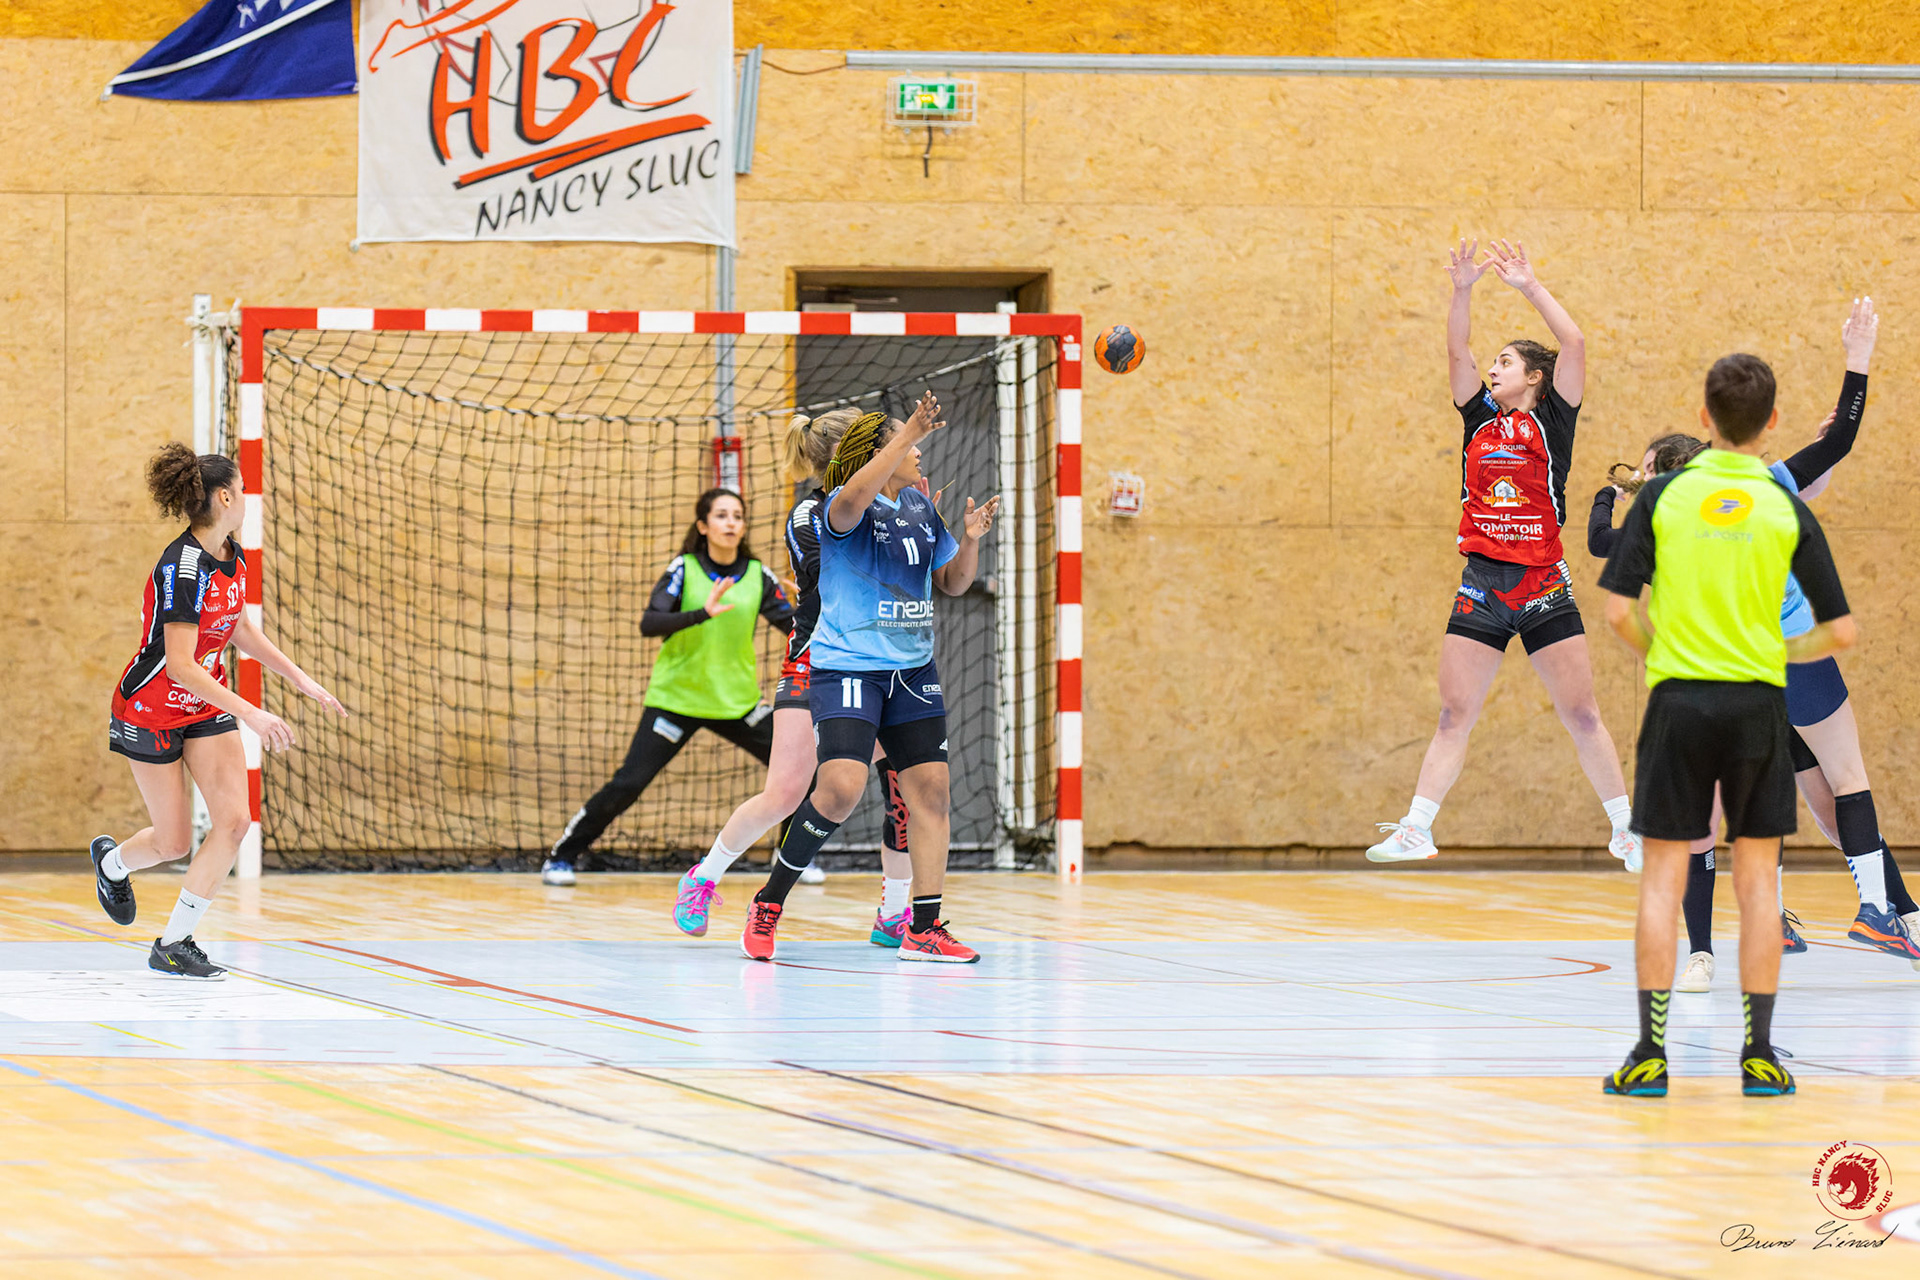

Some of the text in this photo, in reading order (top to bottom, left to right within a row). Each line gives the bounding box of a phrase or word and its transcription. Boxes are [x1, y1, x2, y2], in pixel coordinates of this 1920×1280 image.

[428, 3, 699, 165] HBC
[475, 139, 721, 237] NANCY SLUC
[1848, 391, 1864, 421] KIPSTA
[1694, 529, 1754, 543] LA POSTE
[902, 537, 919, 565] 11
[166, 564, 175, 592] Grand
[841, 677, 862, 709] 11
[803, 820, 829, 837] SELECT
